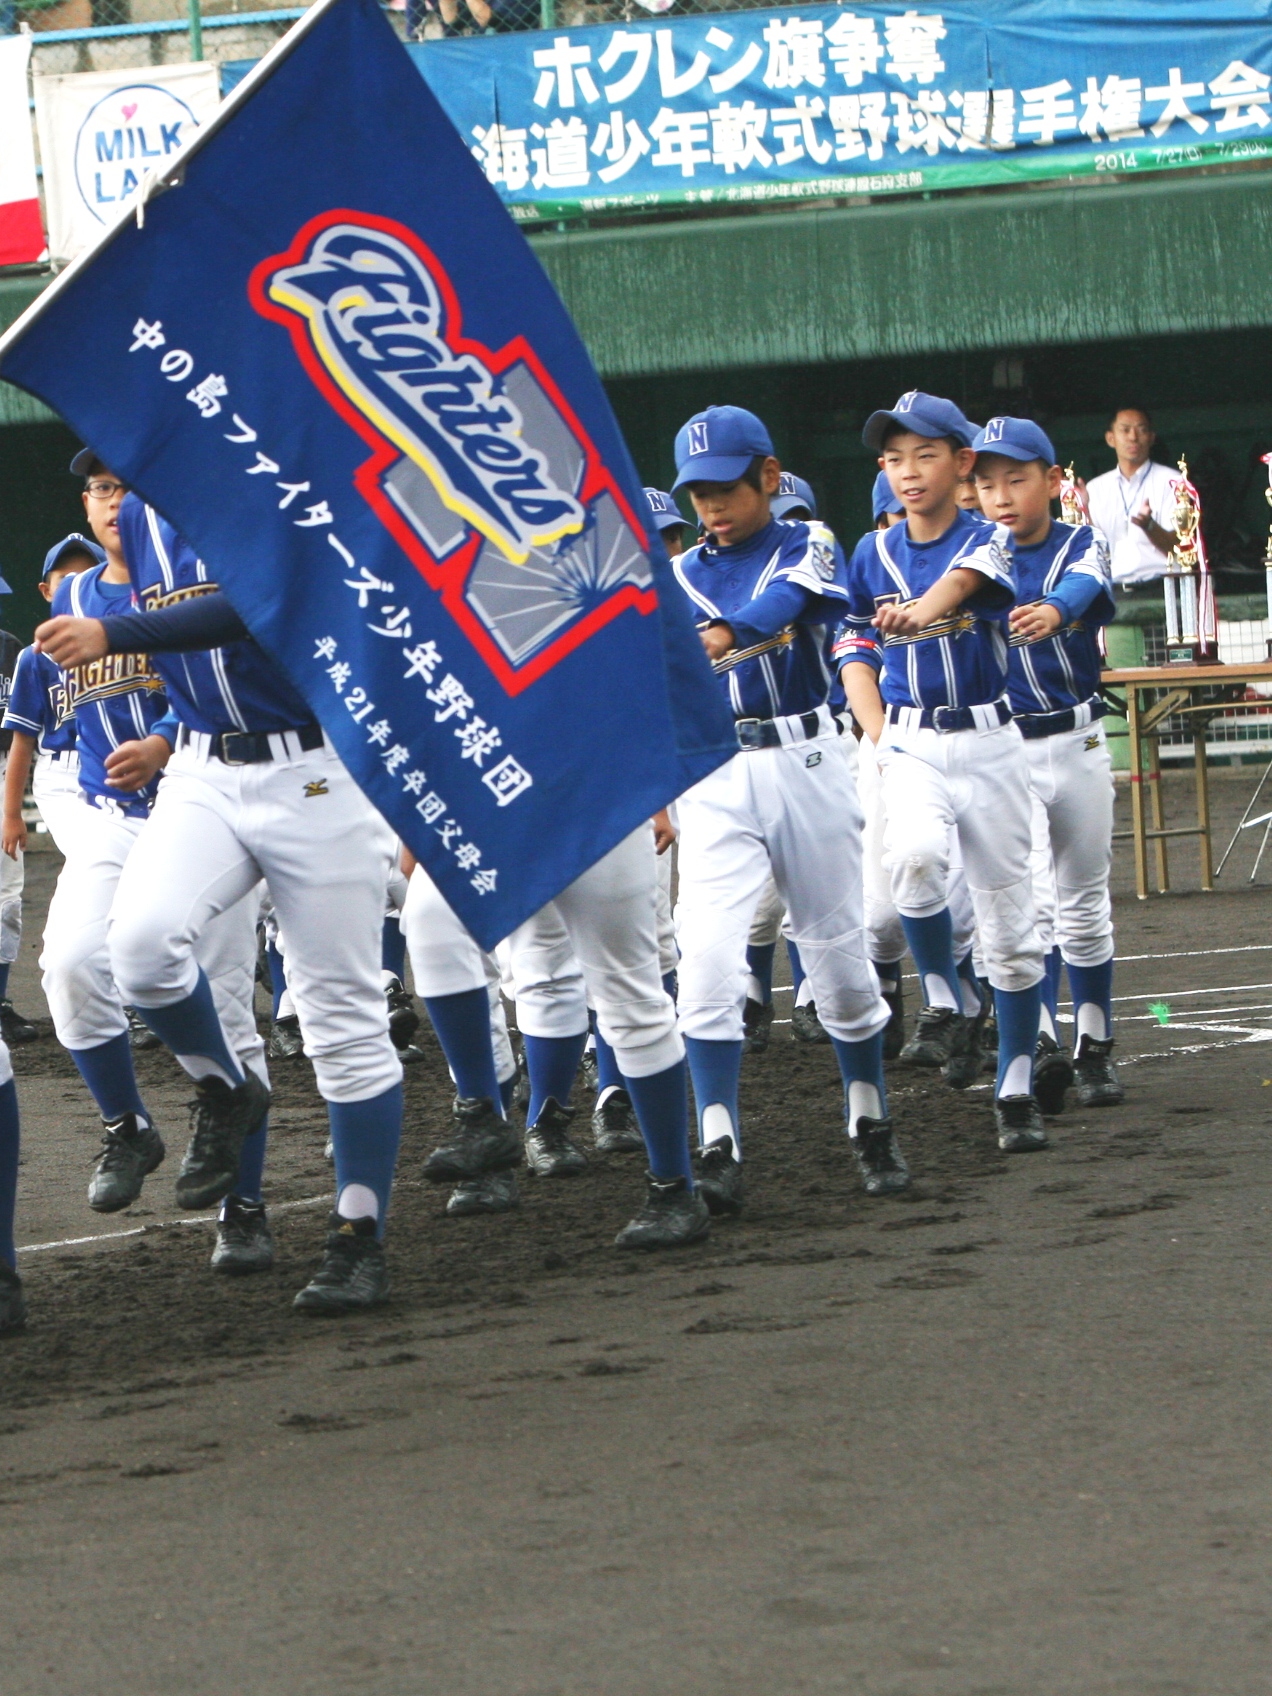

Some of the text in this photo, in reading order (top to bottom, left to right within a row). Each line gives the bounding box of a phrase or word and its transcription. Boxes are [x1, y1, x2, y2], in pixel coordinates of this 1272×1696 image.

[533, 10, 947, 108] ホクレン旗争奪
[95, 121, 182, 162] MILK
[1094, 152, 1137, 171] 2014
[95, 166, 150, 203] LA
[272, 225, 586, 556] Fighters
[688, 422, 709, 456] N
[984, 418, 1005, 443] N
[646, 492, 667, 511] N
[779, 475, 796, 495] N
[129, 317, 532, 807] 中の島ファイターズ少年野球団
[313, 635, 498, 895] 平成21年度卒団父母会
